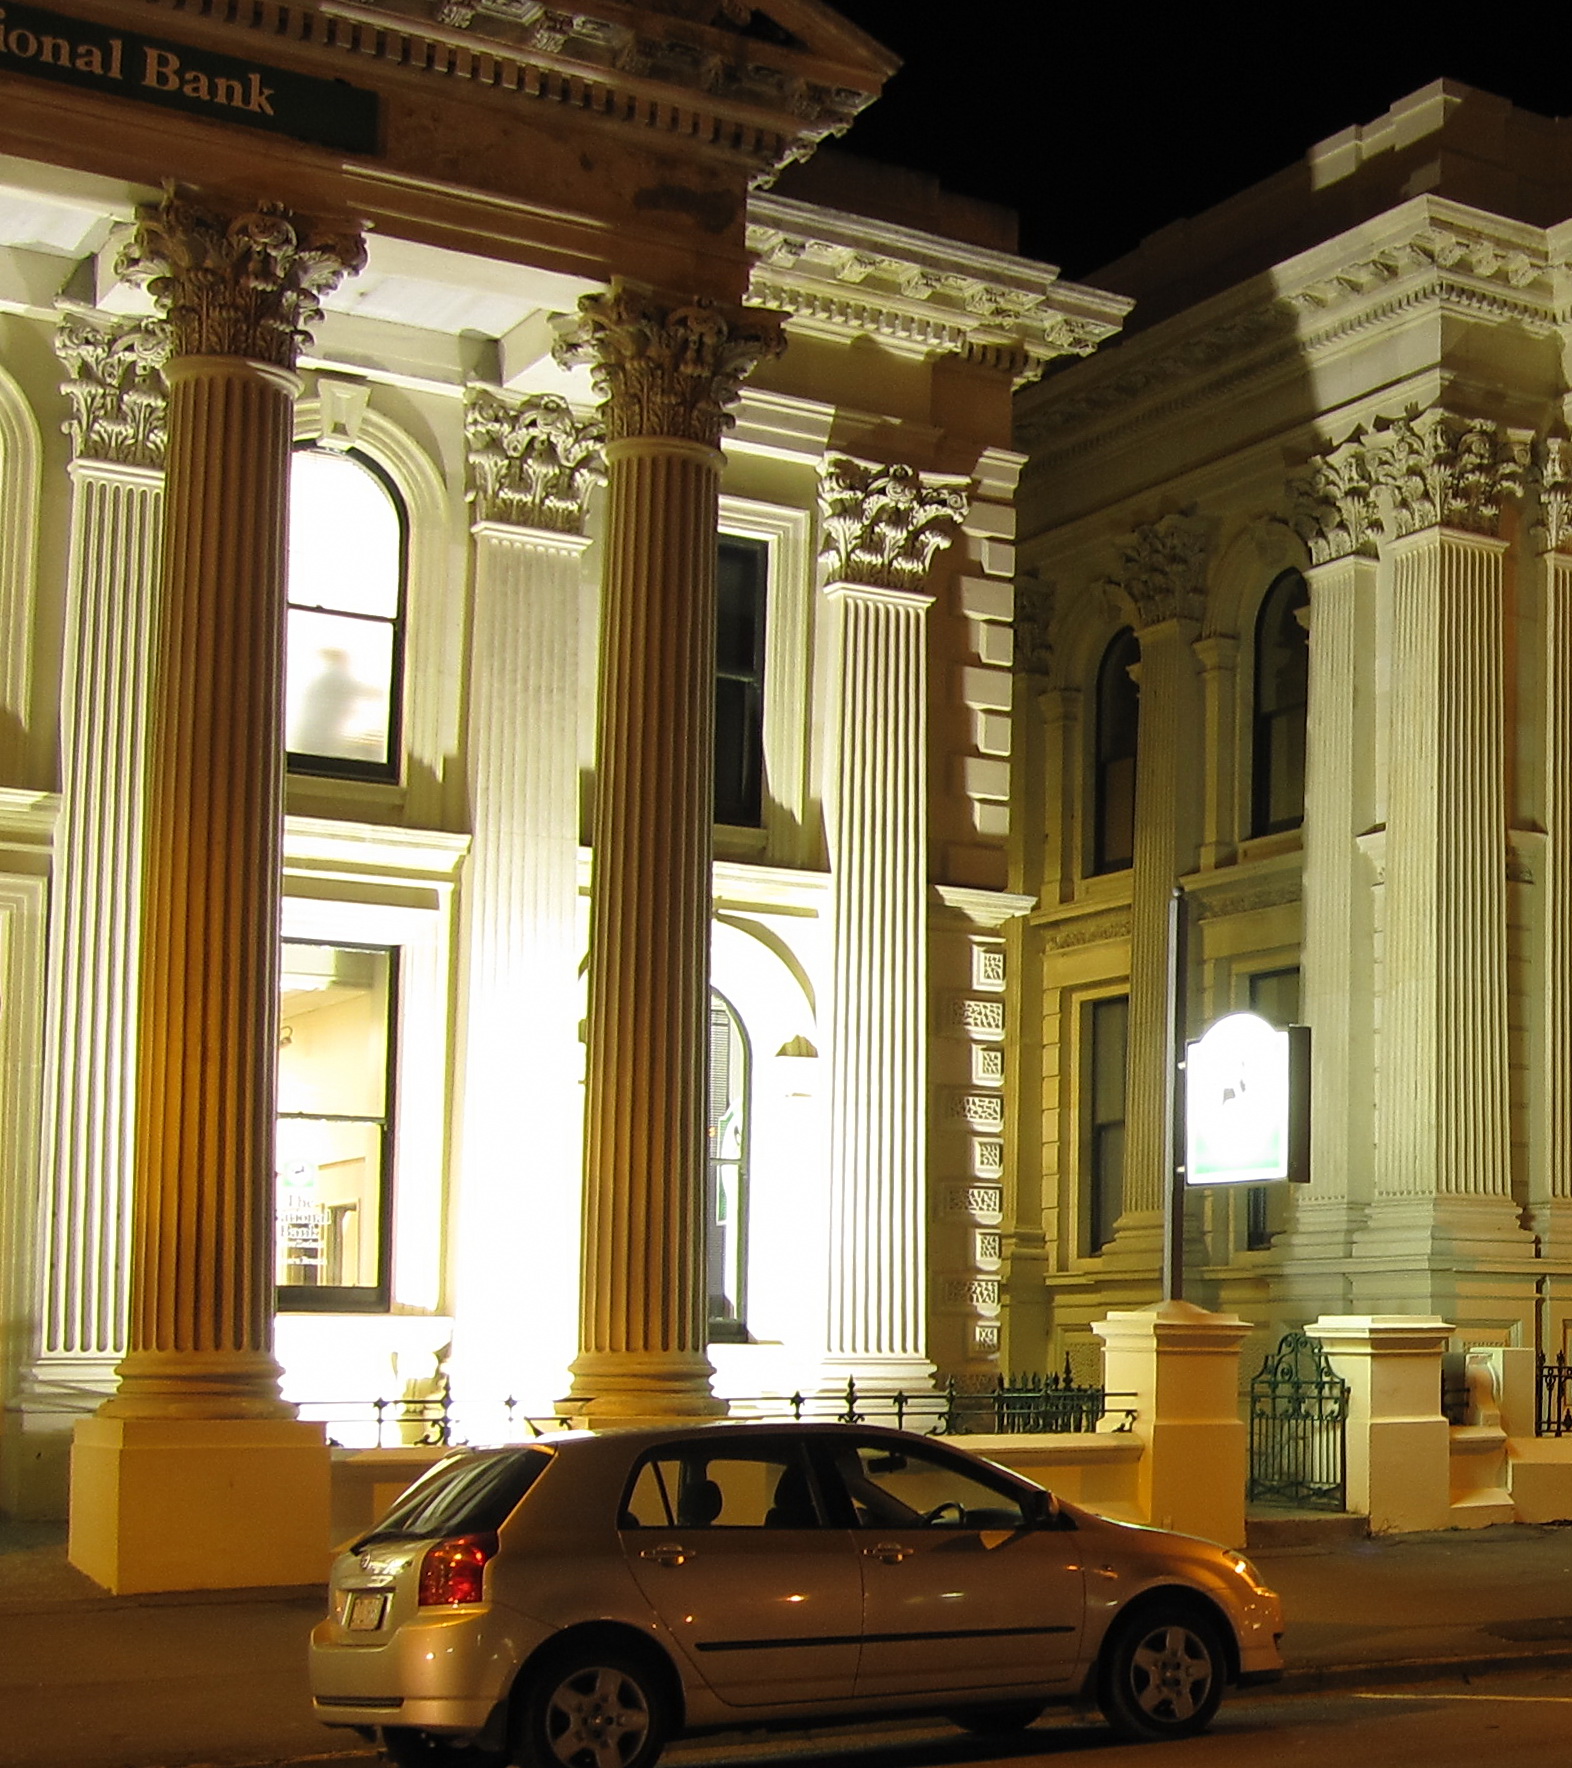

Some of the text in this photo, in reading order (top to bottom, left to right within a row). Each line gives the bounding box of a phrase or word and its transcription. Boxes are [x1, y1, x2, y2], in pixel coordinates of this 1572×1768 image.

[141, 45, 276, 116] Bank
[276, 1209, 331, 1224] ational
[279, 1223, 321, 1238] Bank
